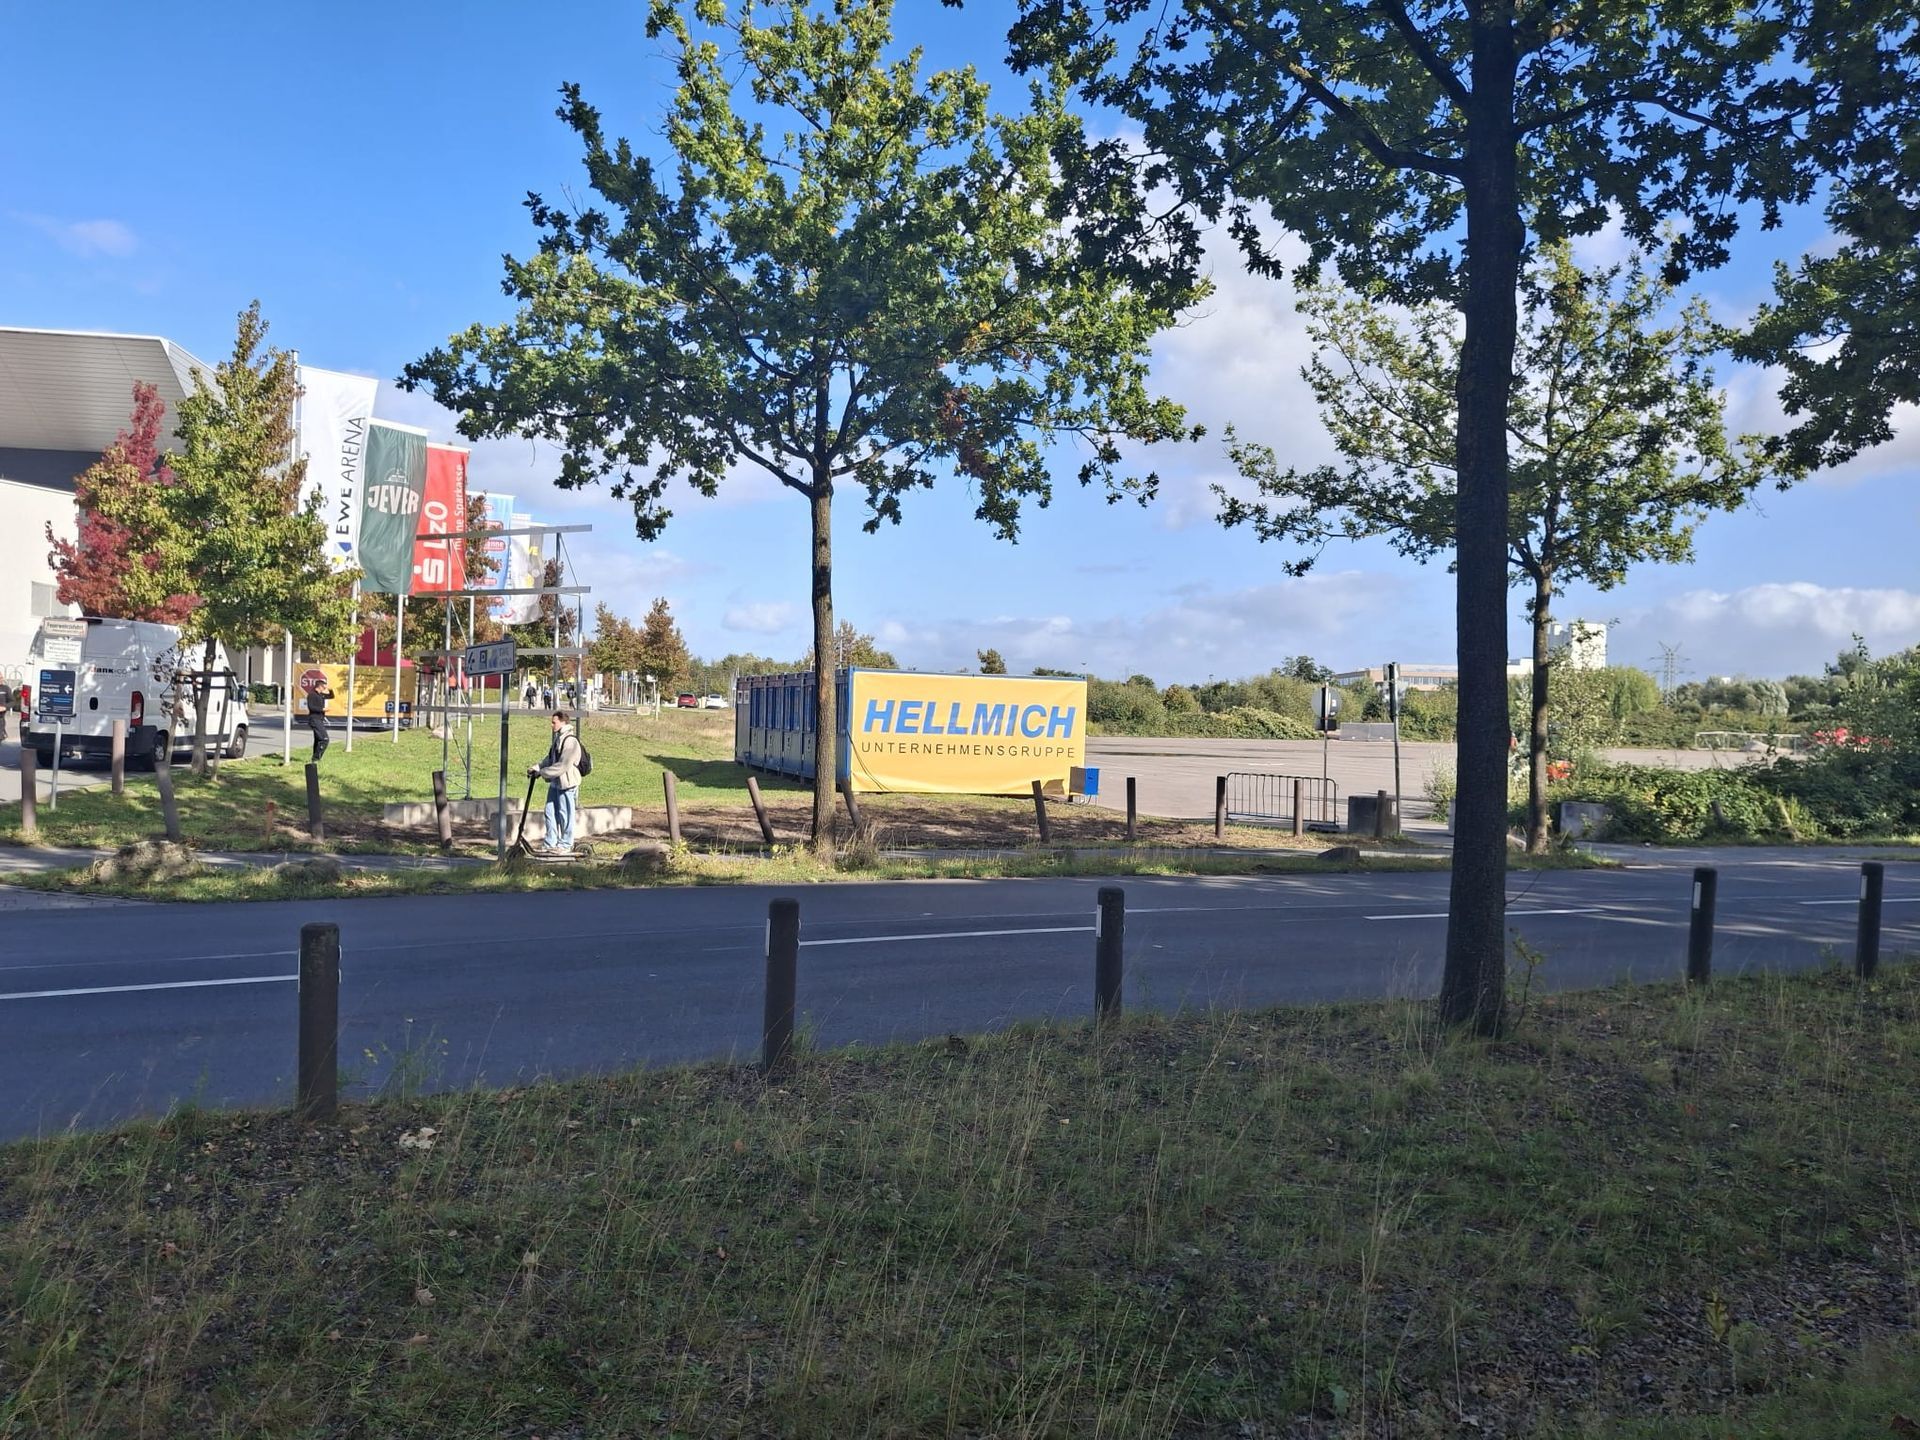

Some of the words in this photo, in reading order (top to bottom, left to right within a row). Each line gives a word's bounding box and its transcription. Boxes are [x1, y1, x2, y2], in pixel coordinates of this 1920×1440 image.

[341, 417, 365, 482] ARENA
[336, 488, 352, 534] EWE
[367, 485, 420, 515] JEVER
[302, 678, 327, 687] STO
[863, 699, 1076, 738] HELLMICH
[861, 742, 1075, 758] UNTERNEHMENSGRUPPE
